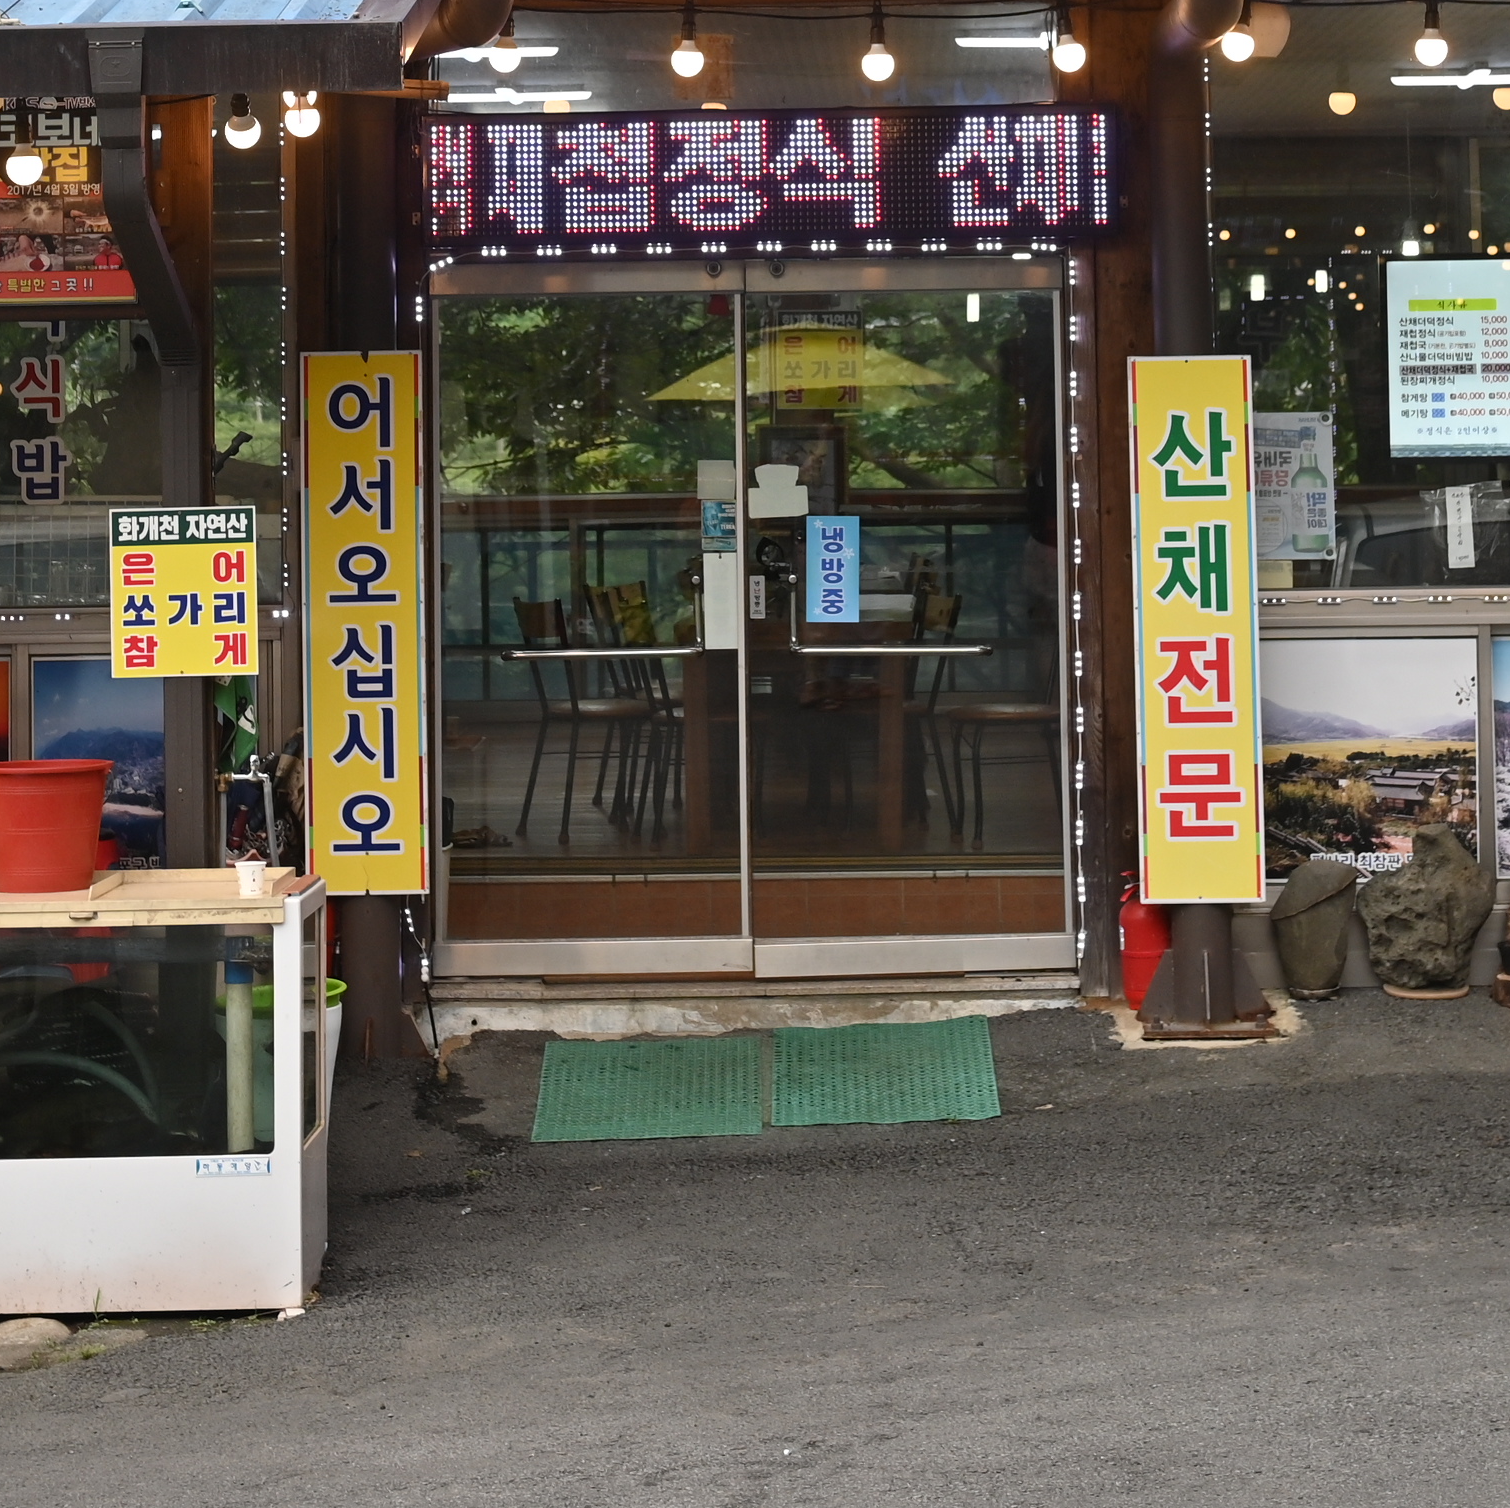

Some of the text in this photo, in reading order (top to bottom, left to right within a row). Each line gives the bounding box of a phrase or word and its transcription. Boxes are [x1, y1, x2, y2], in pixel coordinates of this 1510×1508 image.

[7, 184, 101, 196] 2017년 4월 3일 방영
[7, 278, 46, 292] 특별한
[51, 280, 61, 291] 그
[66, 278, 78, 291] 곳
[83, 277, 94, 291] !!
[1399, 315, 1508, 327] 산채더덕정식 15,000
[1399, 327, 1509, 339] 재첩정식 12,000
[1399, 339, 1509, 351] 재첩국 8,000
[1399, 351, 1509, 363] 산나물더덕비빔밥 10,000
[784, 360, 857, 380] 쏘가리
[1400, 365, 1475, 376] 산채더덕정식+재첩국
[1400, 374, 1509, 386] 된장찌개정식 10,000
[1400, 393, 1429, 403] 참게탕
[1401, 409, 1429, 419] 메기탕
[118, 513, 248, 542] 화개천 자연산
[122, 550, 245, 586] 은어
[821, 526, 845, 615] 냉방중
[123, 592, 246, 627] 쏘가리
[327, 375, 402, 855] 어서오십시오
[1152, 410, 1243, 839] 산채전문
[123, 633, 248, 668] 참게
